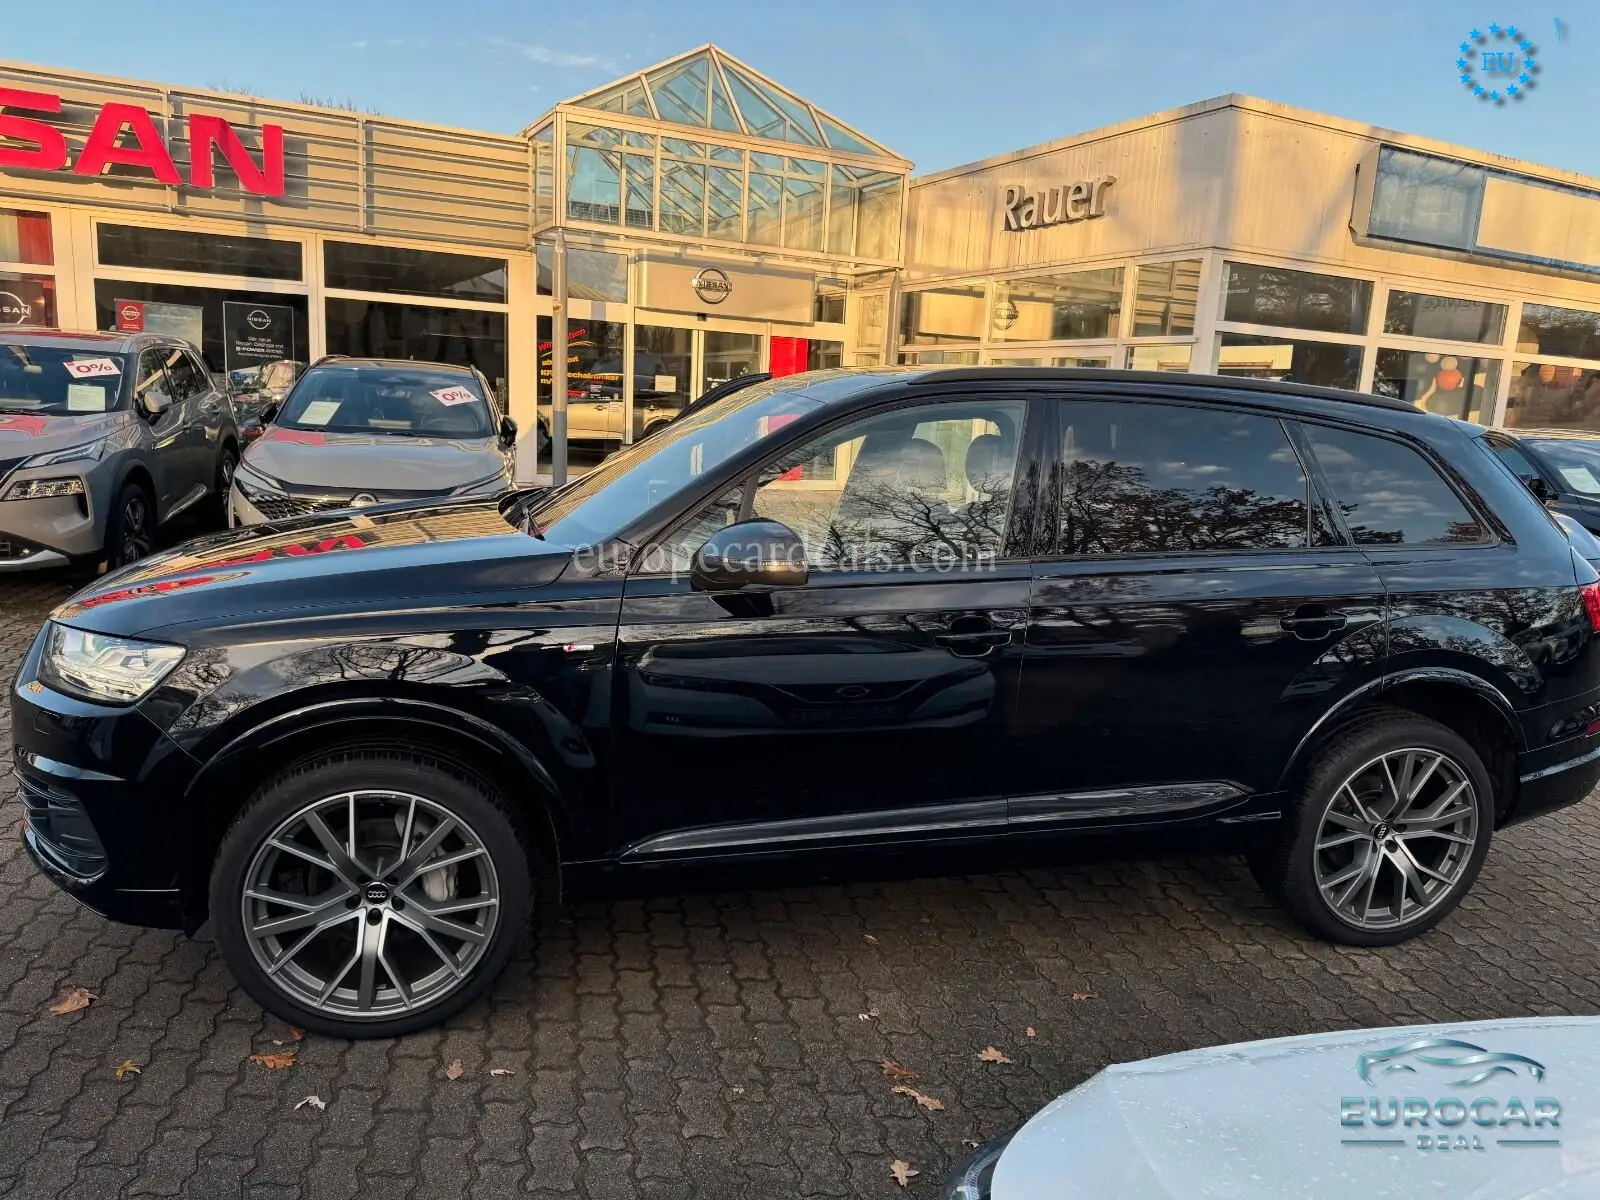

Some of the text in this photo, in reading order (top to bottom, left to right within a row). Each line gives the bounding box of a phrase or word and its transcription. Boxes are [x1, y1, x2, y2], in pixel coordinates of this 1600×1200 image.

[1000, 175, 1117, 231] Rauer
[696, 280, 731, 292] NISSAN
[0, 306, 30, 315] SAN
[247, 315, 272, 323] NISSAN
[76, 363, 113, 374] 0%
[442, 391, 471, 401] 0%
